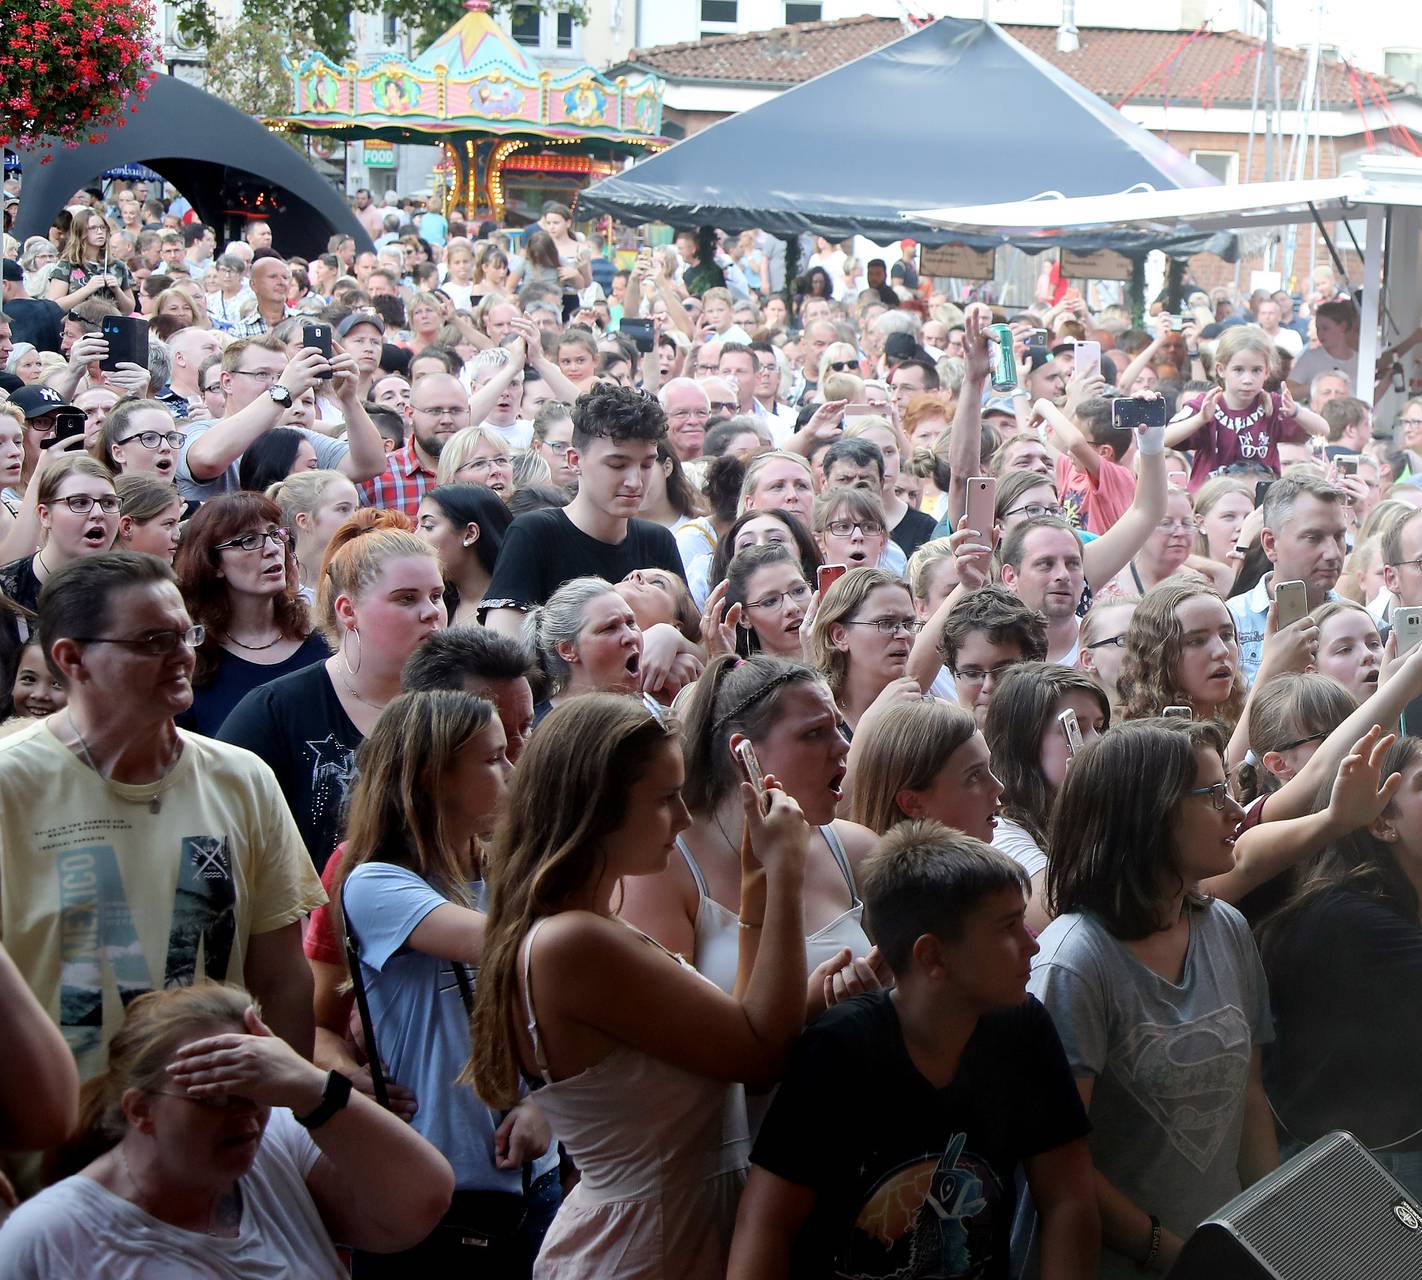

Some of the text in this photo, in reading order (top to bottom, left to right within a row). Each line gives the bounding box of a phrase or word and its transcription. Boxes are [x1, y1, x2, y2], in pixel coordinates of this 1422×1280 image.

[364, 149, 393, 163] FOOD
[39, 388, 61, 402] NY
[60, 853, 98, 959] MEXICO
